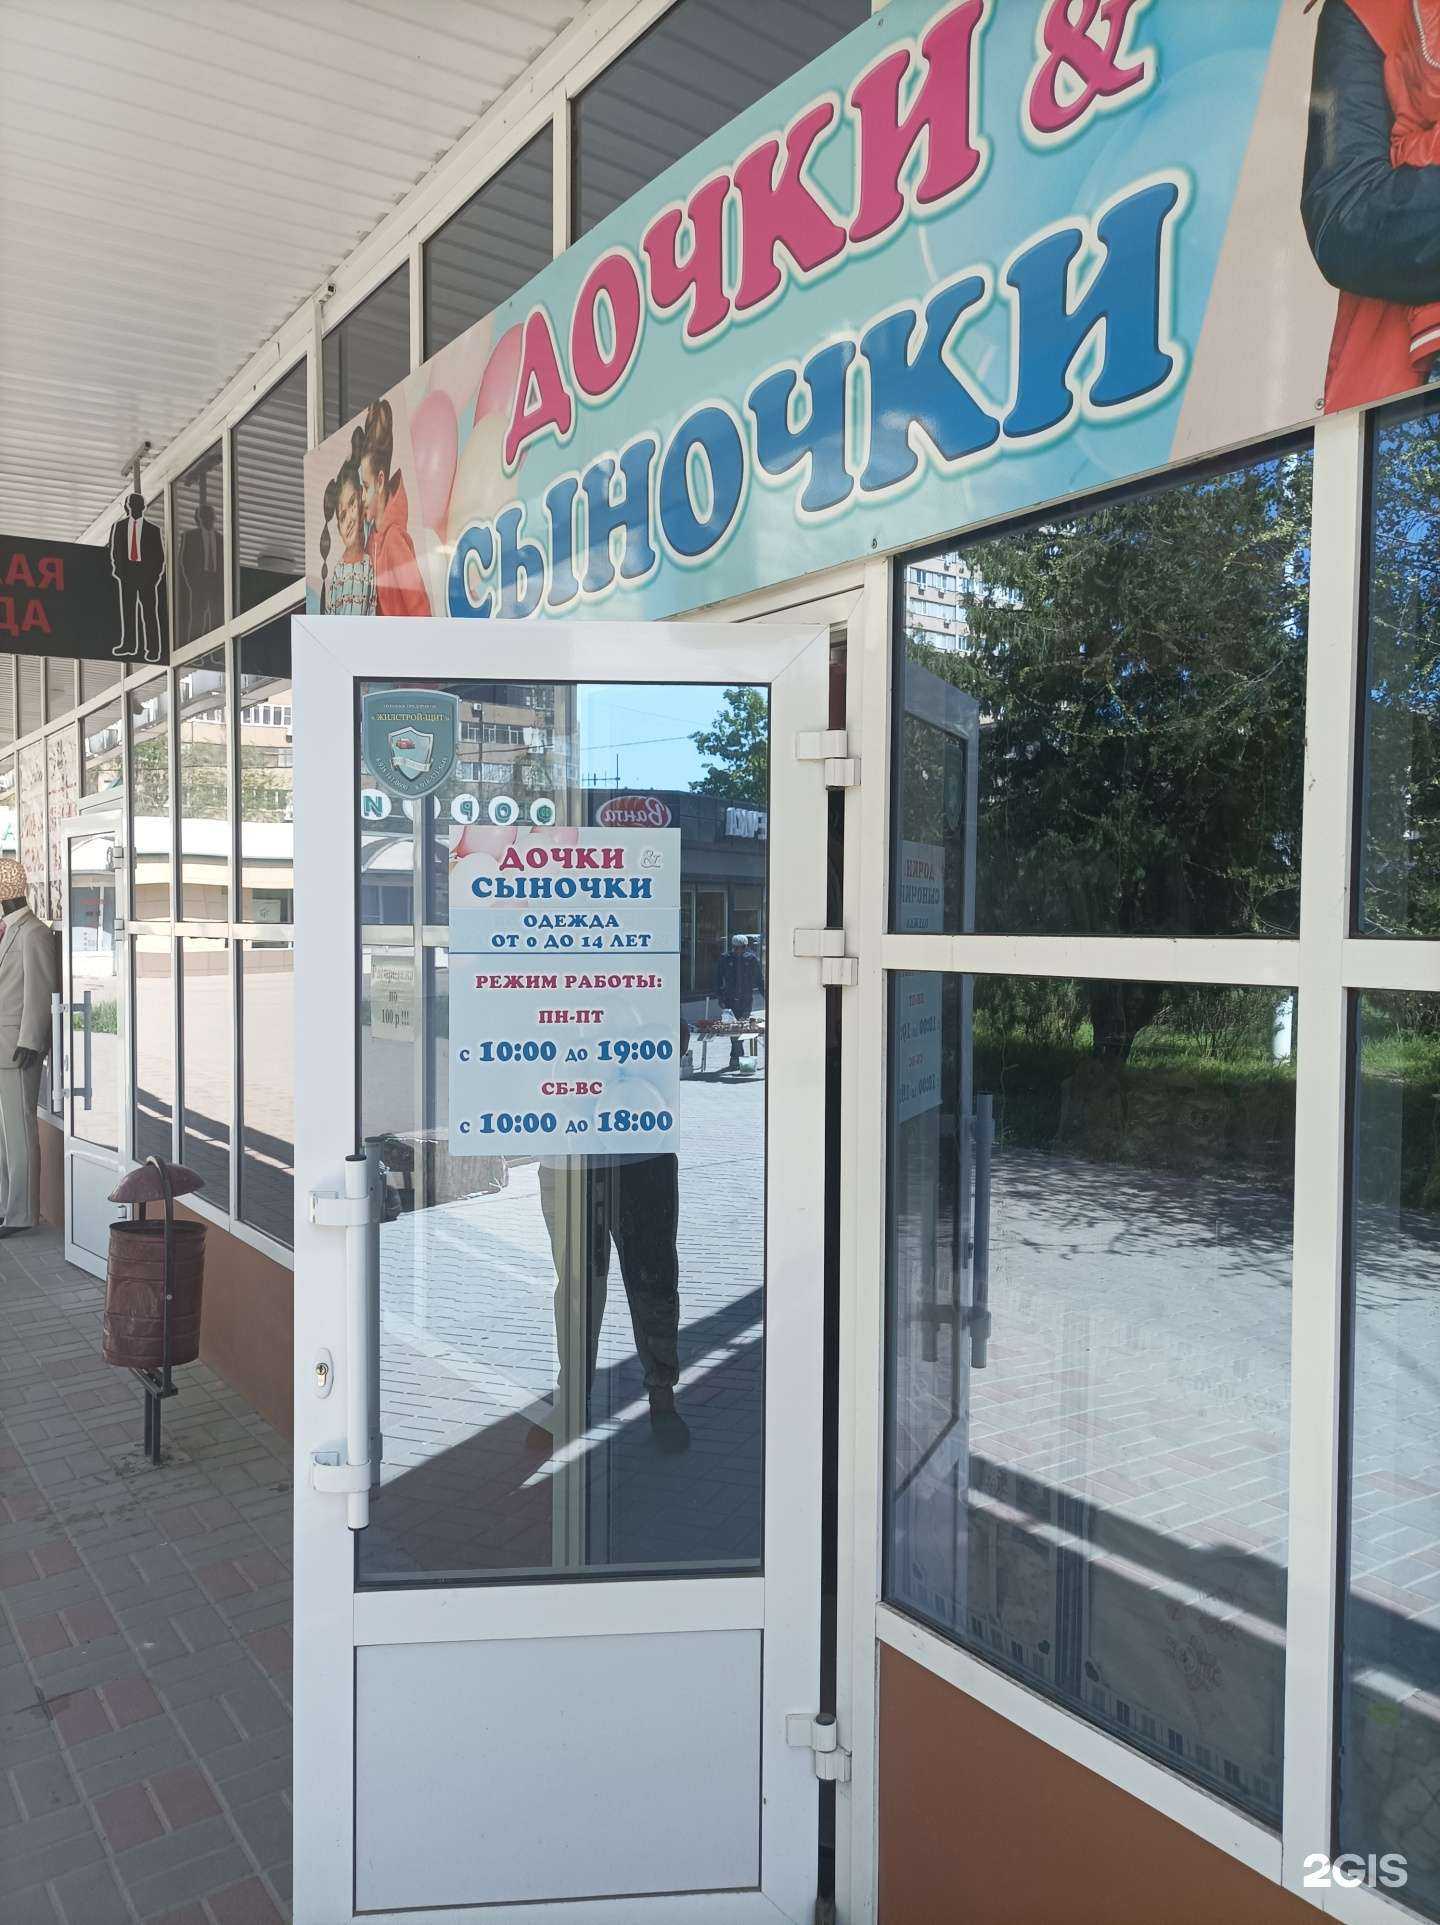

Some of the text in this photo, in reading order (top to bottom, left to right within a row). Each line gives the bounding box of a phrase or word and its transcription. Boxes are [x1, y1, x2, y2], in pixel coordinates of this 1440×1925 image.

[505, 0, 1146, 466] ДОЧКИ &
[448, 182, 1179, 619] СЫНОЧКИ
[0, 553, 65, 592] АЯ
[499, 847, 625, 871] ДОЧКИ
[471, 876, 653, 899] СЫНОЧКИ
[523, 914, 619, 930] ОДЕЖДА
[491, 934, 519, 948] ОТ
[543, 934, 574, 949] ДО
[581, 935, 604, 949] 14
[610, 934, 651, 947] ЛЕТ
[475, 974, 663, 989] РЕЖИМ РАБОТЫ:
[538, 1009, 604, 1024] ПН-ПТ
[479, 1040, 557, 1062] 10:00
[565, 1049, 588, 1063] до
[597, 1039, 673, 1064] 19:00
[541, 1081, 603, 1095] СБ-ВС
[479, 1112, 557, 1134] 10:00
[565, 1119, 588, 1134] до
[597, 1109, 673, 1132] 18:00
